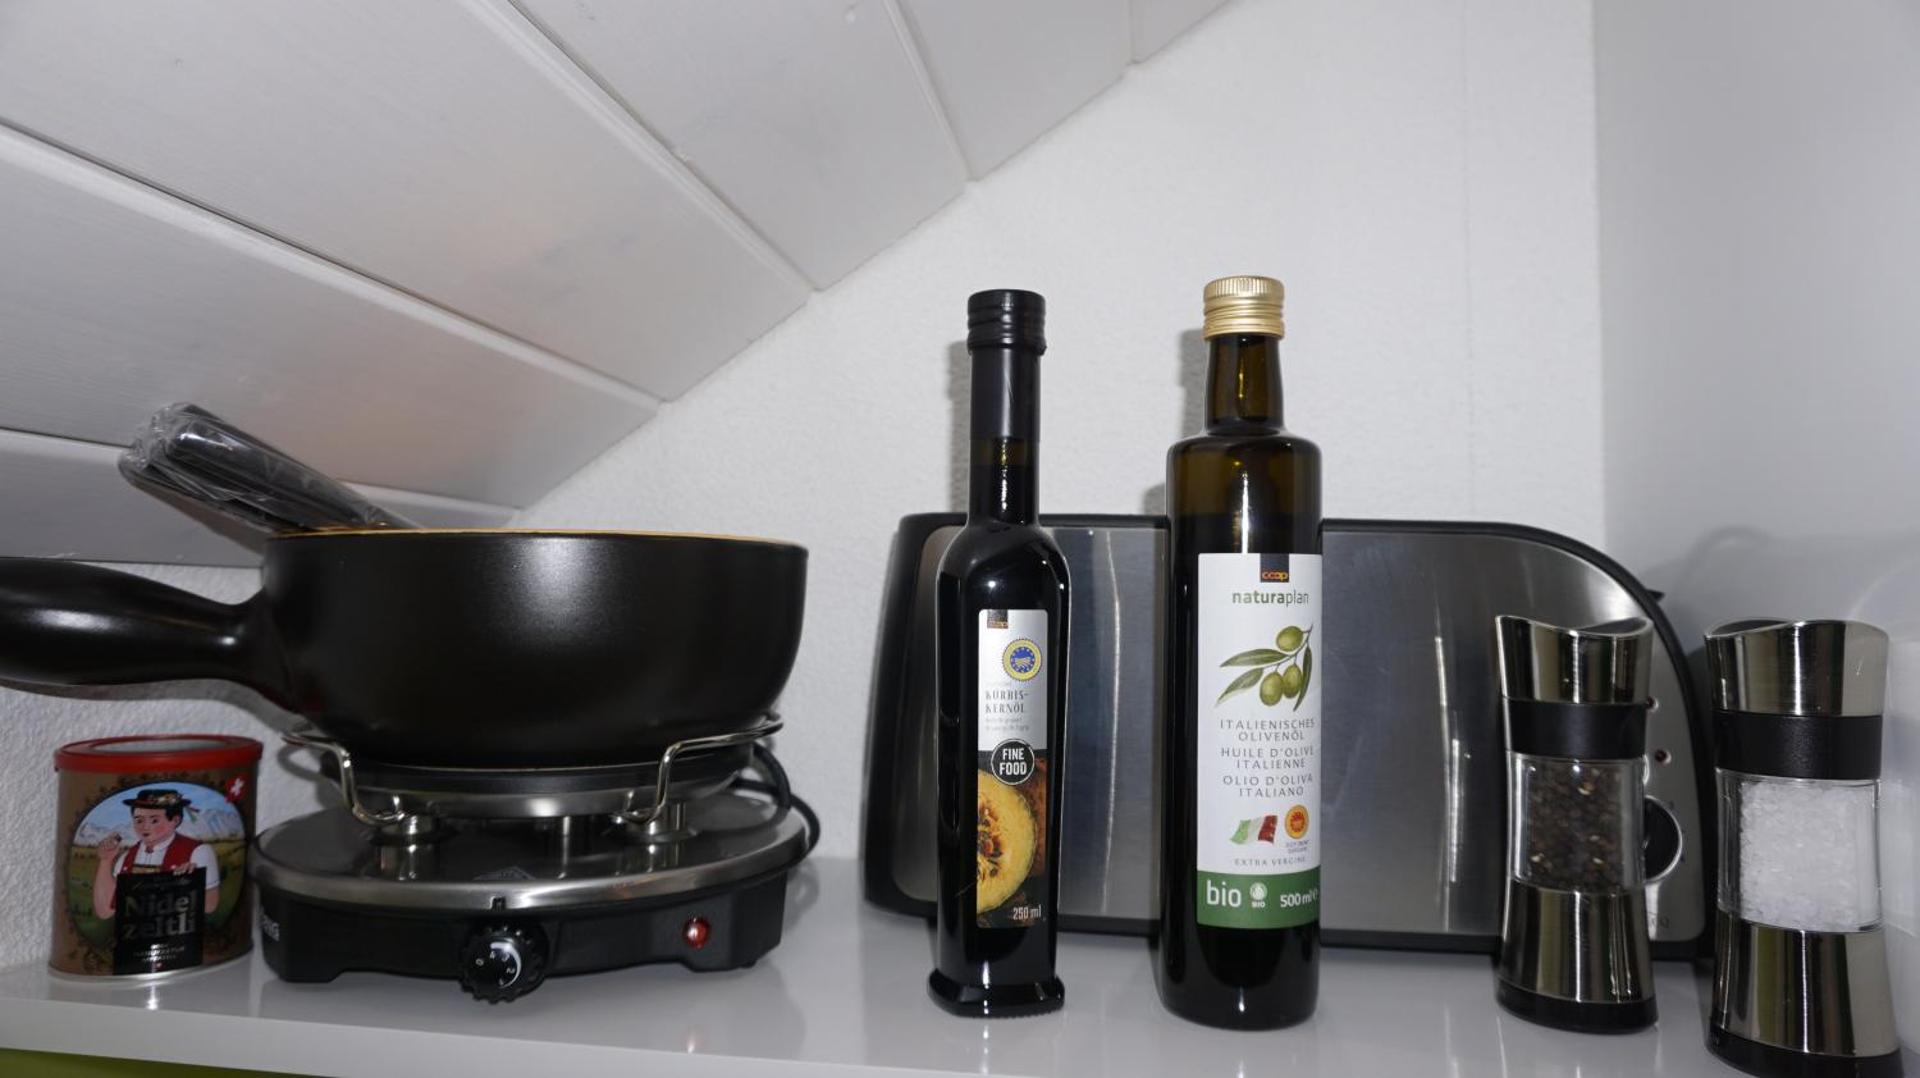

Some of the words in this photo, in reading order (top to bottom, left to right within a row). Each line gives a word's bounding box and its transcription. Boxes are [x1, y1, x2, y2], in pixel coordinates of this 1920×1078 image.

[1261, 571, 1289, 582] coop
[1231, 589, 1309, 607] naturaplan
[1220, 718, 1315, 730] ITALIENISCHES
[1238, 730, 1304, 742] OLIVENÖL
[1002, 747, 1025, 761] FINE
[1221, 747, 1264, 758] HUILE
[1270, 746, 1315, 758] D'OLIVE
[999, 761, 1028, 775] FOOD
[1236, 758, 1306, 770] ITALIENNE
[1222, 775, 1260, 786] OLIO
[1265, 773, 1313, 786] D'OLIVA
[1239, 786, 1304, 798] ITALIANO
[1234, 857, 1268, 867] EXTRA
[1206, 879, 1242, 907] bio
[1280, 892, 1302, 908] 500
[123, 888, 198, 917] Nidel
[1013, 905, 1028, 920] 250
[1030, 905, 1042, 919] ml
[121, 912, 197, 940] zeltli
